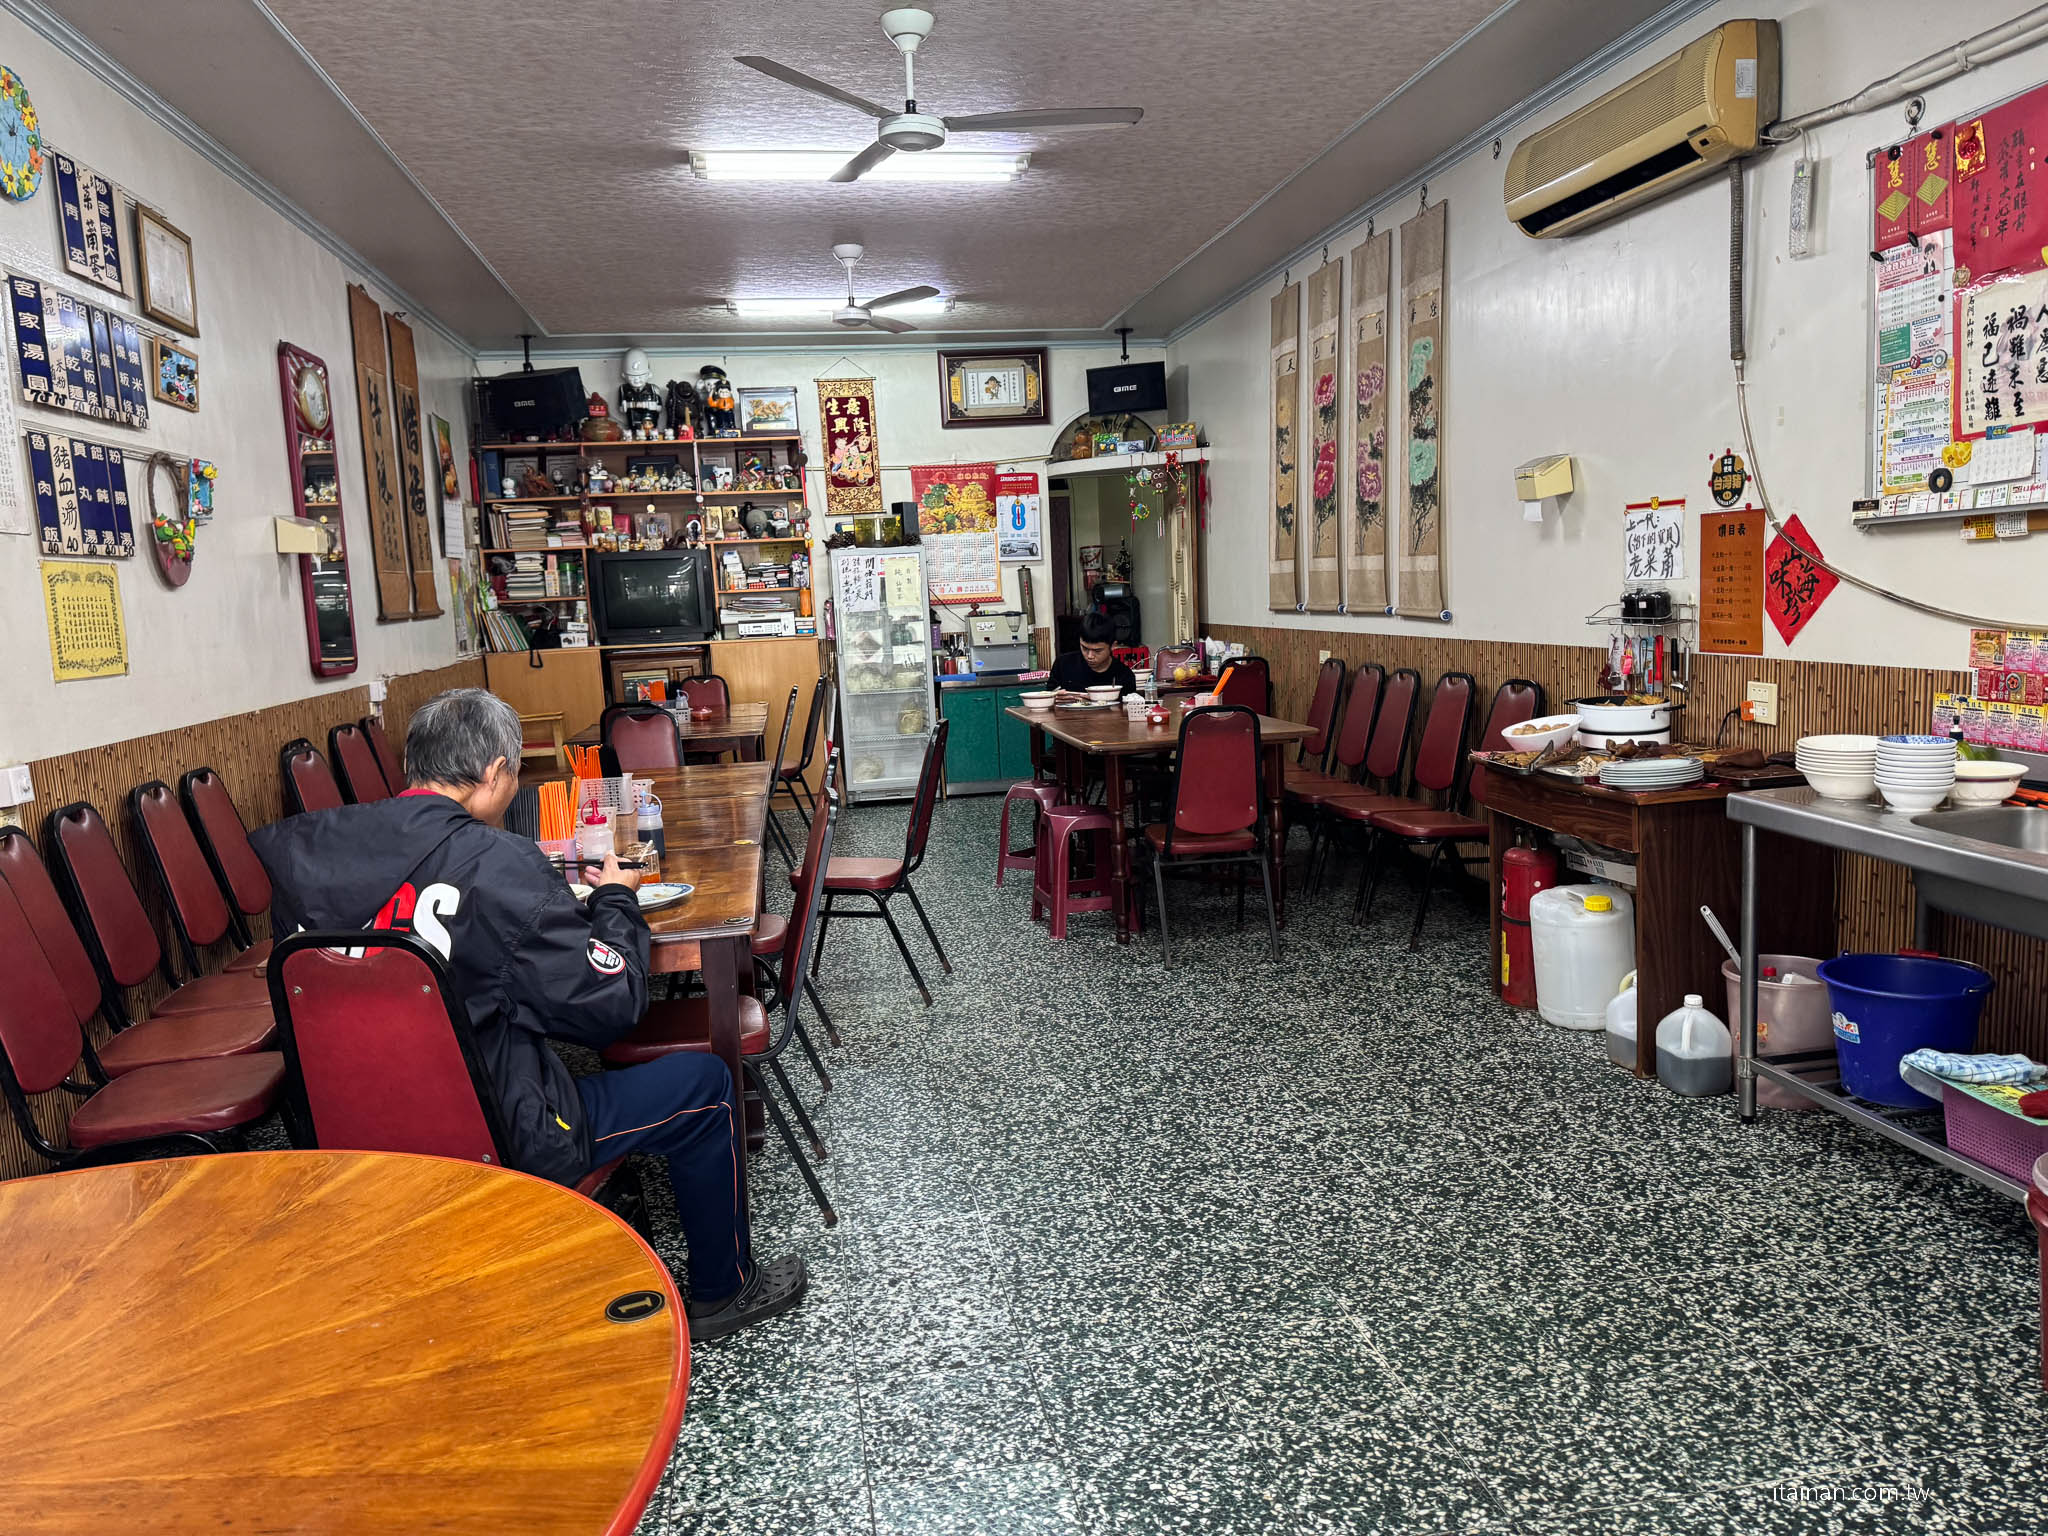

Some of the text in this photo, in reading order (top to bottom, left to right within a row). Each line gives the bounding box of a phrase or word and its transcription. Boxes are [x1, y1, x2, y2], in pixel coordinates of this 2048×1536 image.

[59, 158, 86, 265] 炒青菜
[14, 279, 48, 391] 客家湯圓
[2006, 304, 2028, 418] 禍雖未至
[826, 397, 860, 416] 生意
[830, 417, 870, 433] 興隆
[31, 434, 60, 541] 魯肉飯
[53, 446, 79, 552] 豬血湯 40
[73, 442, 98, 544] 貢丸湯
[91, 445, 115, 545] 餛飩湯
[109, 449, 133, 546] 粉腸湯
[1713, 474, 1742, 491] 台灣豬
